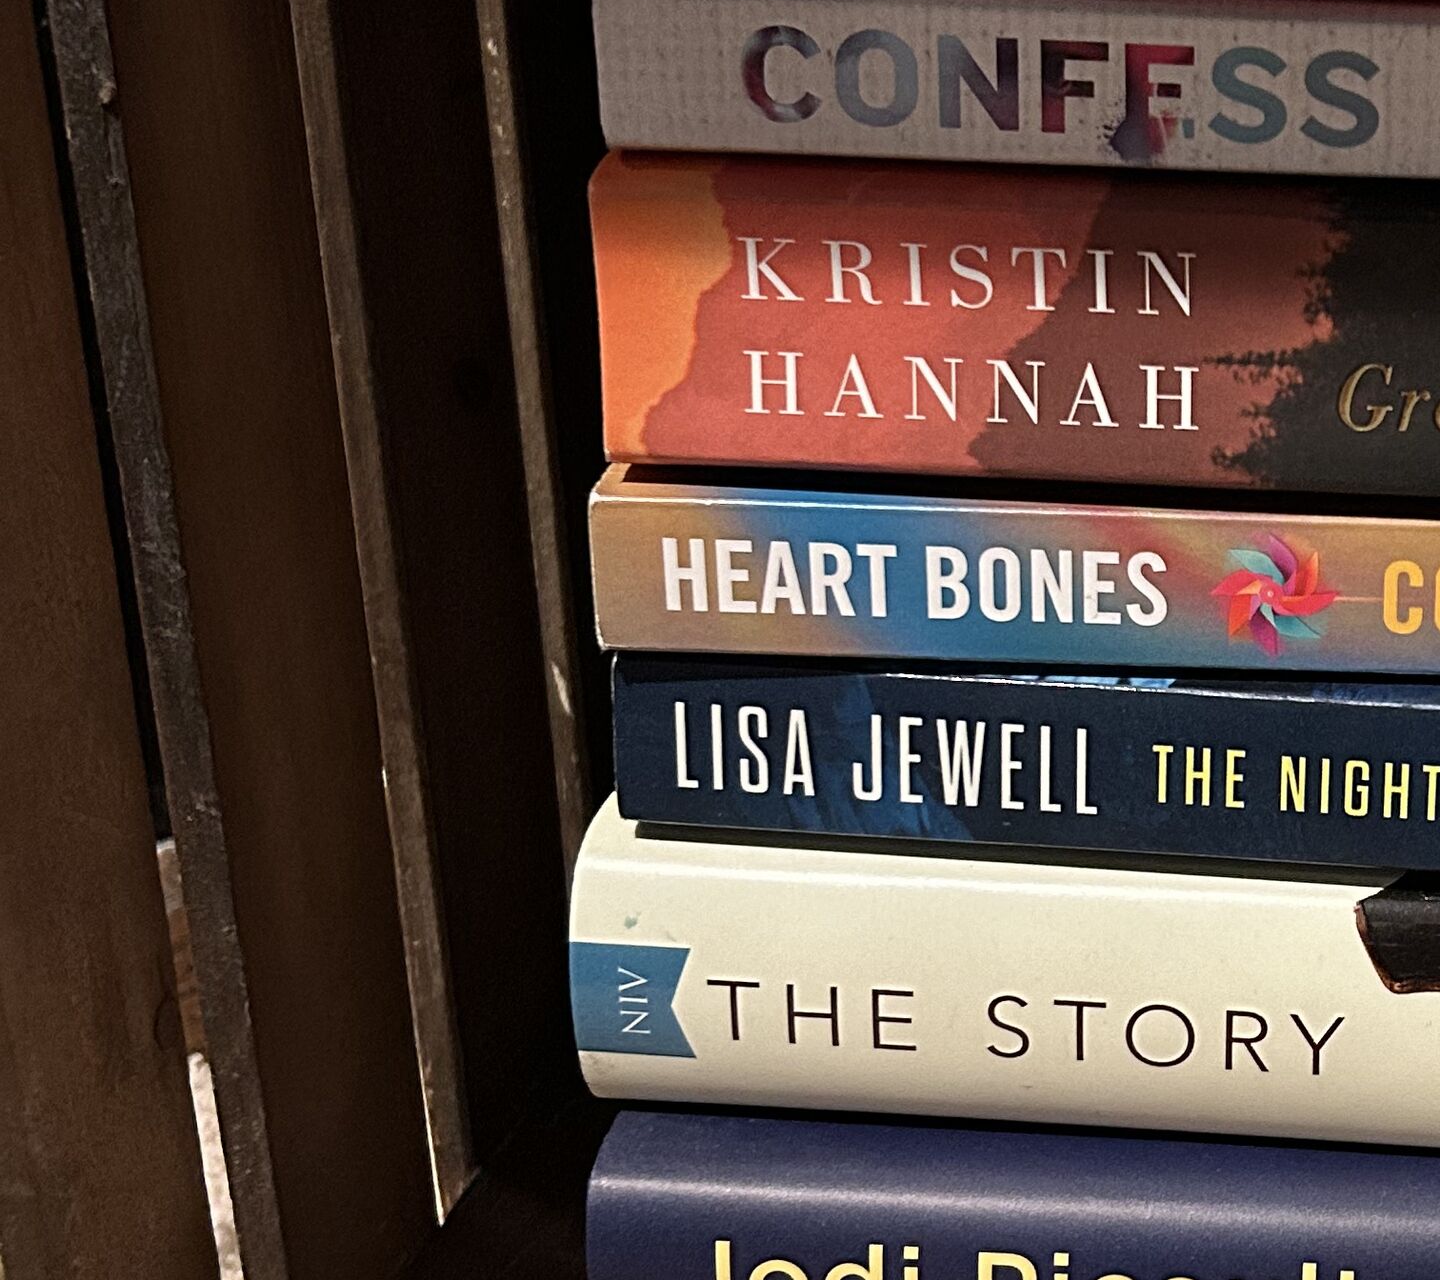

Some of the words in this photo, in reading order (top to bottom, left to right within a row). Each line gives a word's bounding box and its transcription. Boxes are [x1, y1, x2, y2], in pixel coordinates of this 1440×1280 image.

[741, 25, 1381, 152] CONFESS
[737, 237, 1197, 317] KRISTIN
[742, 350, 1200, 431] HANNAH
[661, 537, 897, 618] HEART
[926, 546, 1169, 627] BONES
[674, 701, 816, 797] LISA
[851, 714, 1098, 816] JEWELL
[1152, 744, 1246, 808] THE
[617, 966, 651, 1035] NIV
[706, 979, 917, 1052] THE
[987, 994, 1346, 1076] STORY
